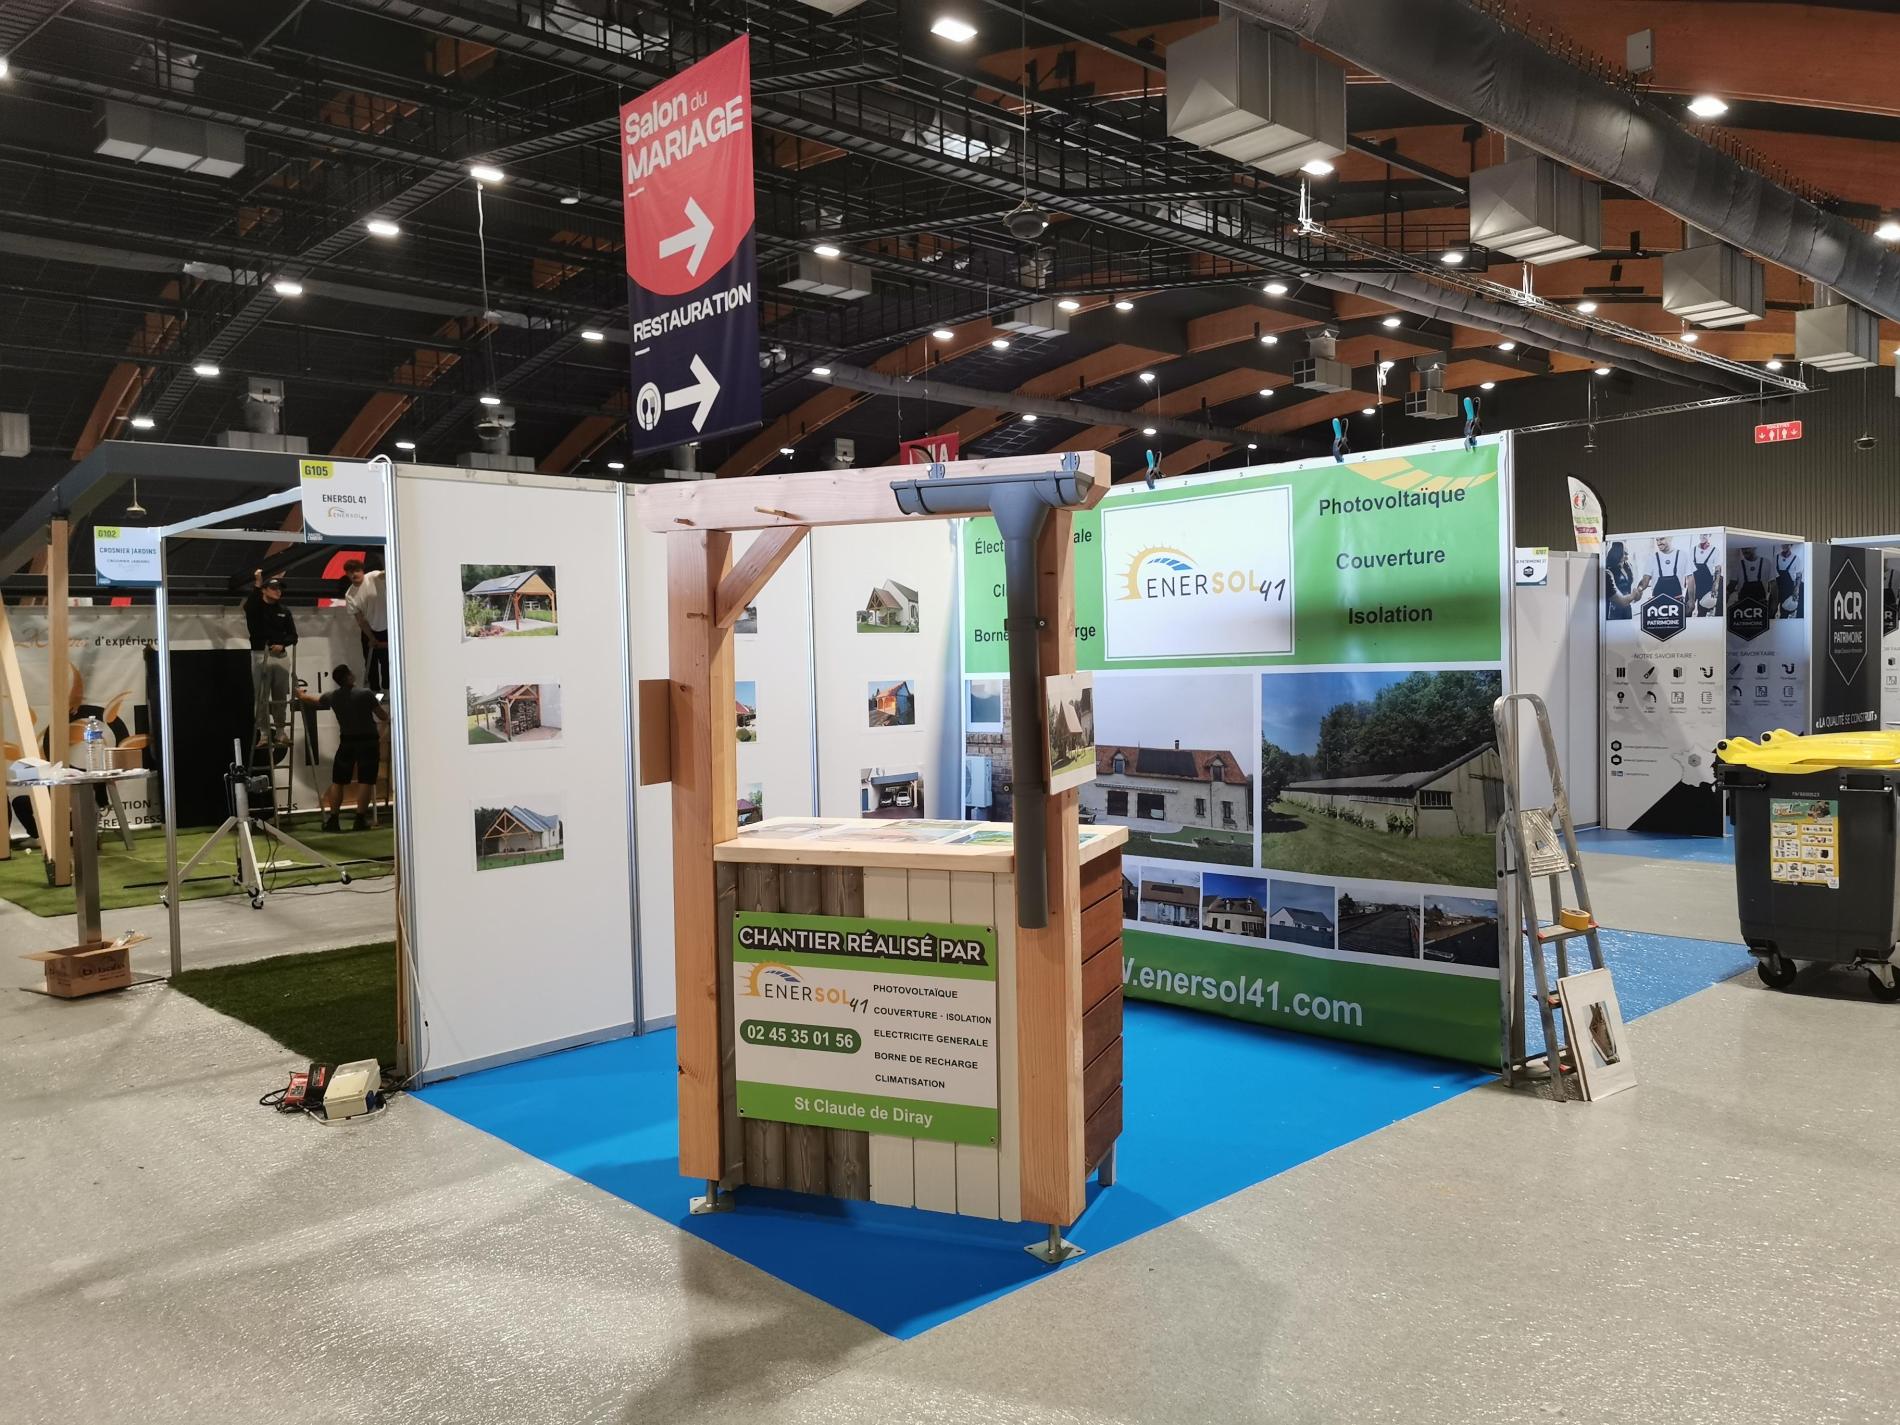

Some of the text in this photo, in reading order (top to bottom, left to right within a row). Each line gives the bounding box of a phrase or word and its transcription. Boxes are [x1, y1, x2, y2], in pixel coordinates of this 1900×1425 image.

[625, 90, 708, 145] Salon du
[627, 95, 744, 185] MARIAGE
[633, 283, 752, 343] RESTAURATION
[304, 464, 329, 477] G105
[322, 493, 367, 504] ENERSOL 41
[1319, 487, 1466, 516] Photovoltaïque
[1336, 548, 1446, 570] Couverture
[1349, 604, 1433, 625] Isolation
[1647, 604, 1680, 617] ACR
[1733, 607, 1763, 619] ACR
[1834, 591, 1863, 620] ACR
[1646, 619, 1680, 627] PATRIMOINE
[974, 629, 1009, 643] Borne
[1833, 631, 1863, 644] PATRIMOINE
[738, 926, 982, 961] CHANTIER RÉALISÉ PAR
[873, 984, 958, 999] PHOTOVOLTAÏQUE
[873, 1006, 938, 1020] COUVERTURE
[945, 1013, 992, 1025] ISOLATION
[747, 1024, 854, 1048] 02 45 35 01 56
[874, 1029, 988, 1048] ELECTRICITE GENERALE
[874, 1051, 979, 1070] BORNE DE RECHARGE
[875, 1074, 946, 1089] CLIMATISATION
[794, 1096, 933, 1129] St Claude de Diray
